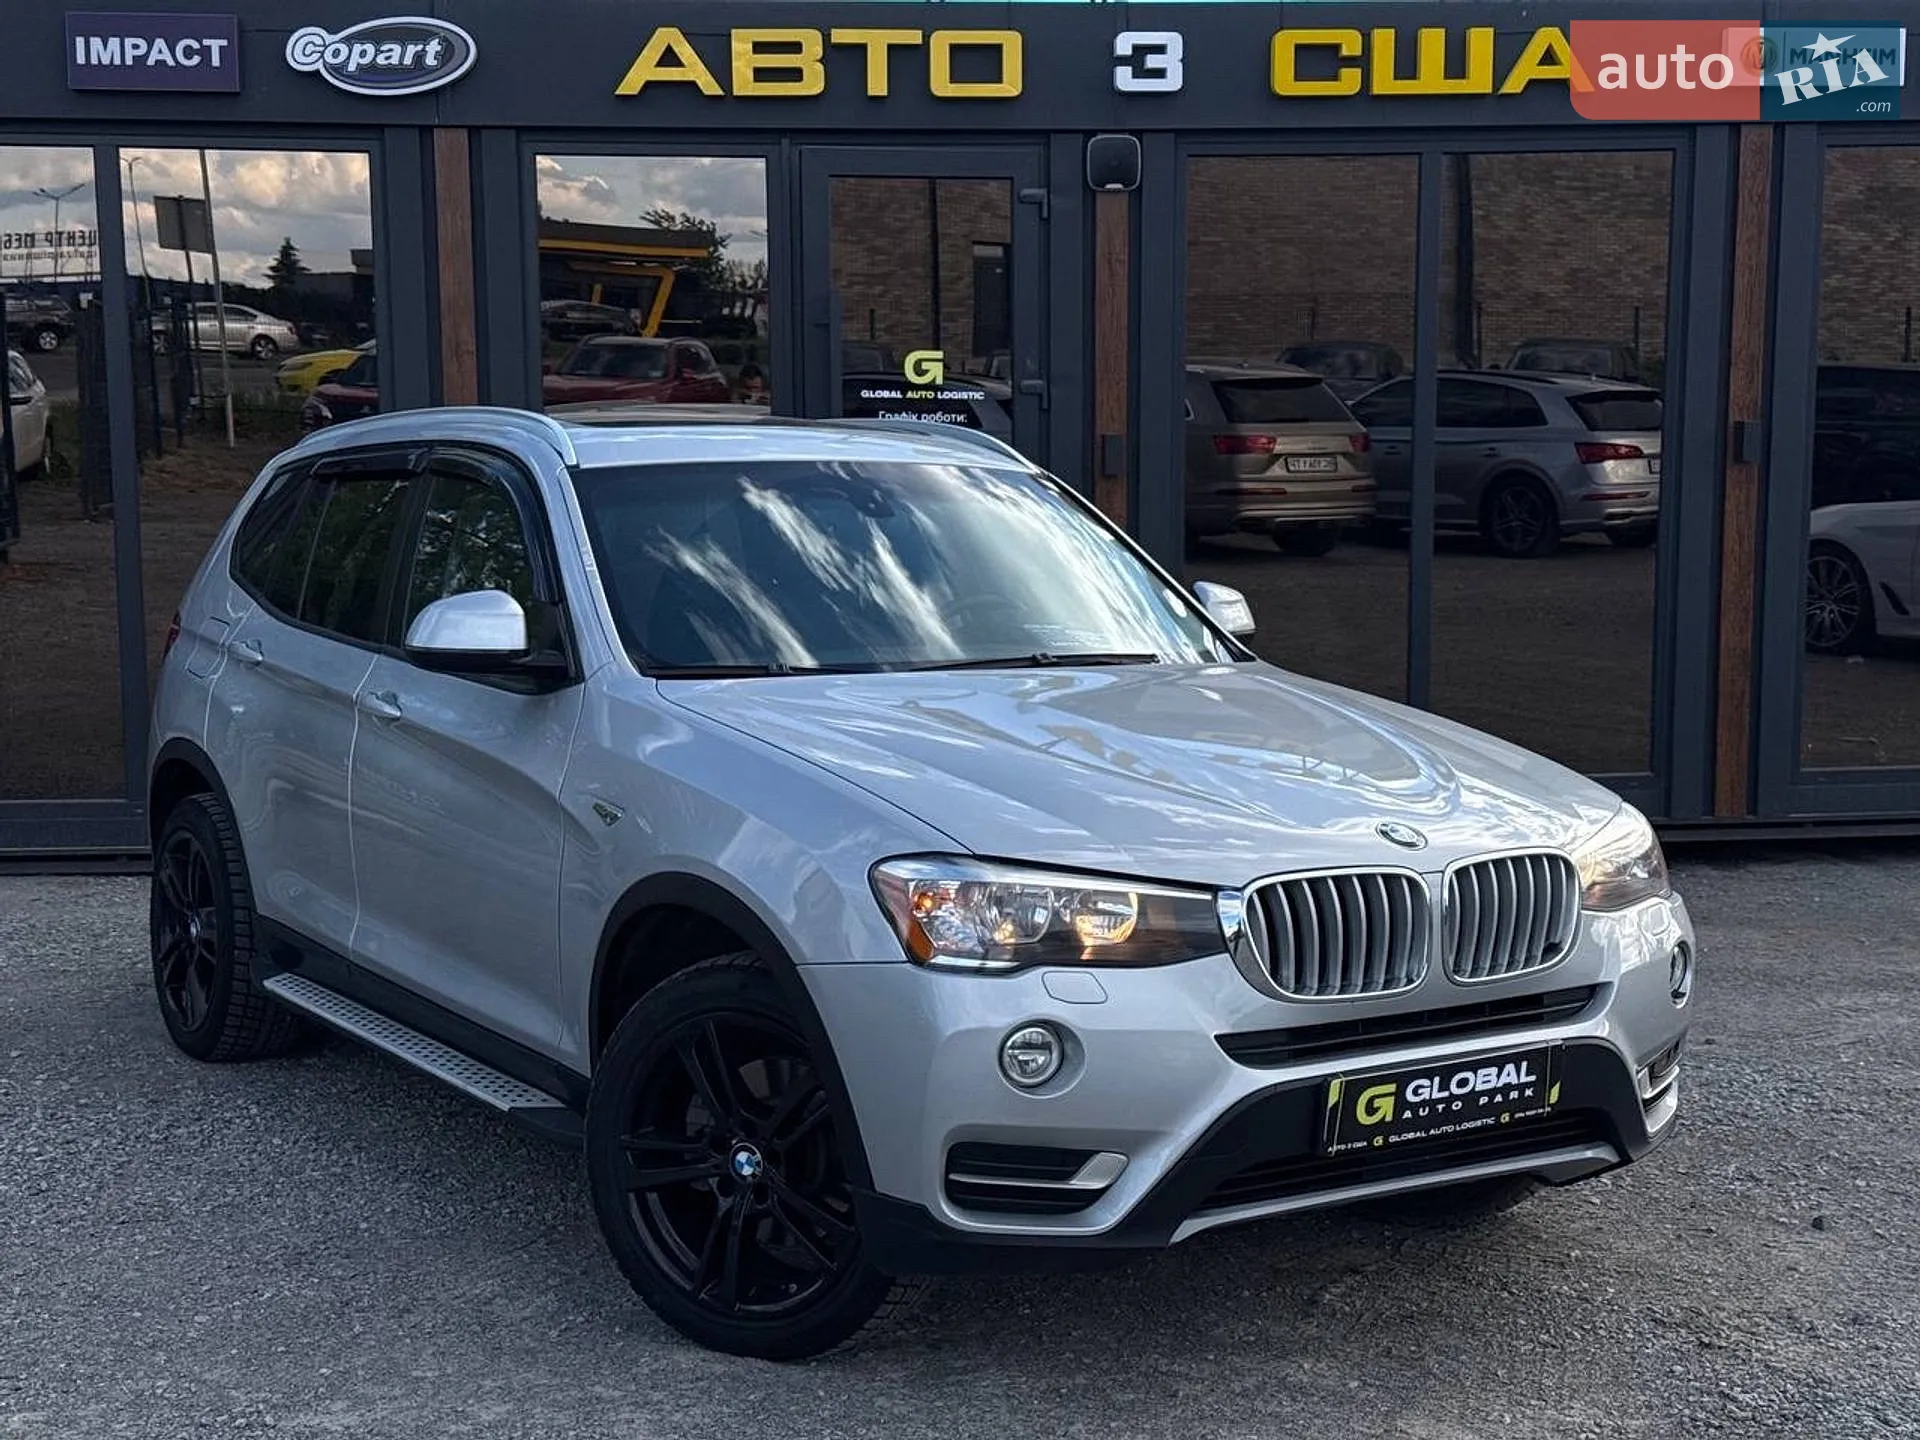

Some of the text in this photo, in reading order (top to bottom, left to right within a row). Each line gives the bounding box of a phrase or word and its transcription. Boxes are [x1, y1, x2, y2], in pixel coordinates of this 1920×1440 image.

[75, 36, 228, 67] IMPACT
[293, 34, 444, 73] Copart
[614, 26, 1024, 98] АВТО
[1271, 26, 1595, 96] США
[1790, 48, 1896, 65] MANHIM
[860, 390, 985, 399] GLOBAL AUTO LOGISTIC
[1405, 1060, 1537, 1102] GLOBAL
[1402, 1087, 1534, 1119] AUTO PARK
[1388, 1131, 1428, 1143] GLOBAL
[1428, 1125, 1454, 1136] AUTO
[1456, 1117, 1496, 1131] LOGISTIC
